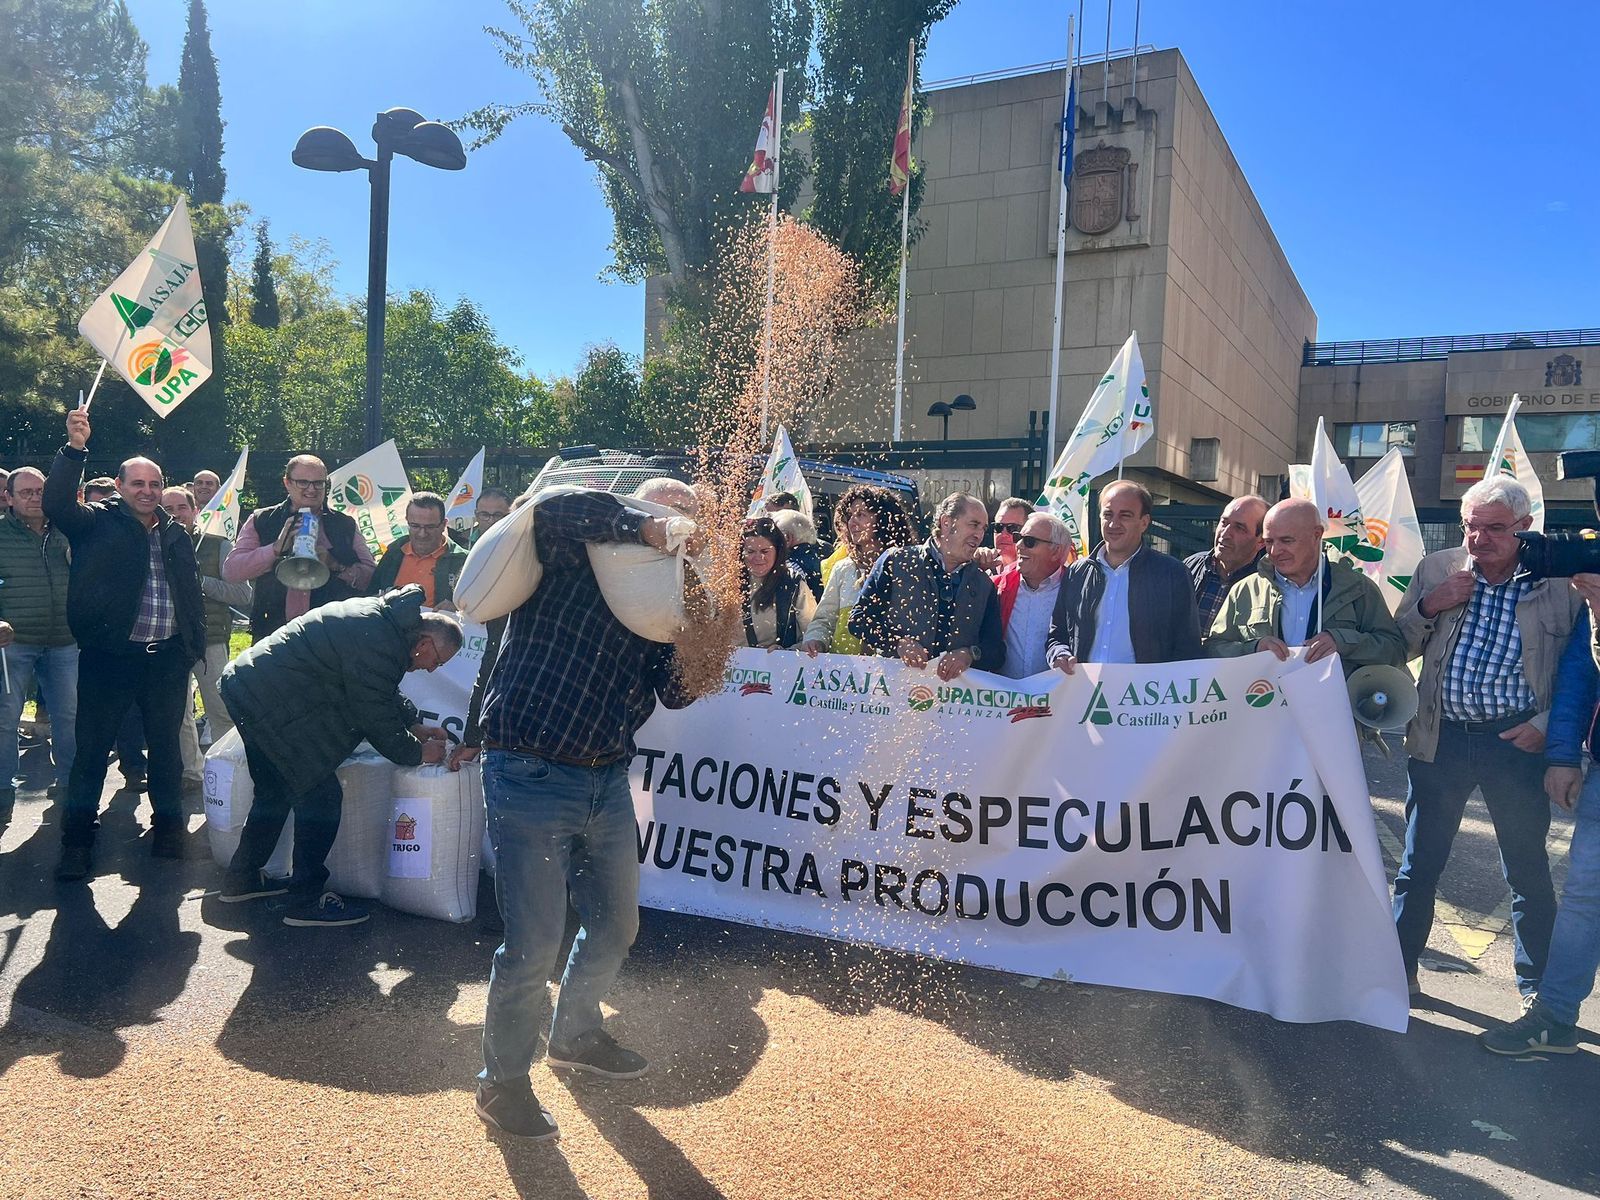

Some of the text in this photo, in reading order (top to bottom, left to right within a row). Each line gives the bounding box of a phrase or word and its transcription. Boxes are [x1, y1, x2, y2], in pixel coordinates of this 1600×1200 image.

[149, 262, 195, 310] ASAJA
[154, 368, 198, 405] UPA
[1468, 393, 1555, 408] GOBIRNO
[1561, 393, 1584, 405] DE
[923, 479, 996, 505] OBIERNO
[811, 668, 891, 697] ASAJA
[1117, 677, 1228, 706] ASAJA
[809, 696, 891, 716] Castilla y León
[937, 686, 1050, 709] UPA COAG
[936, 706, 1003, 719] ALIANZA
[1116, 708, 1228, 729] Castilla y León
[629, 747, 1353, 853] TACIONES Y ESPECULACIÓN
[392, 843, 421, 852] TRIGO
[635, 820, 1232, 934] NUESTRA PRODUCCIÓN
